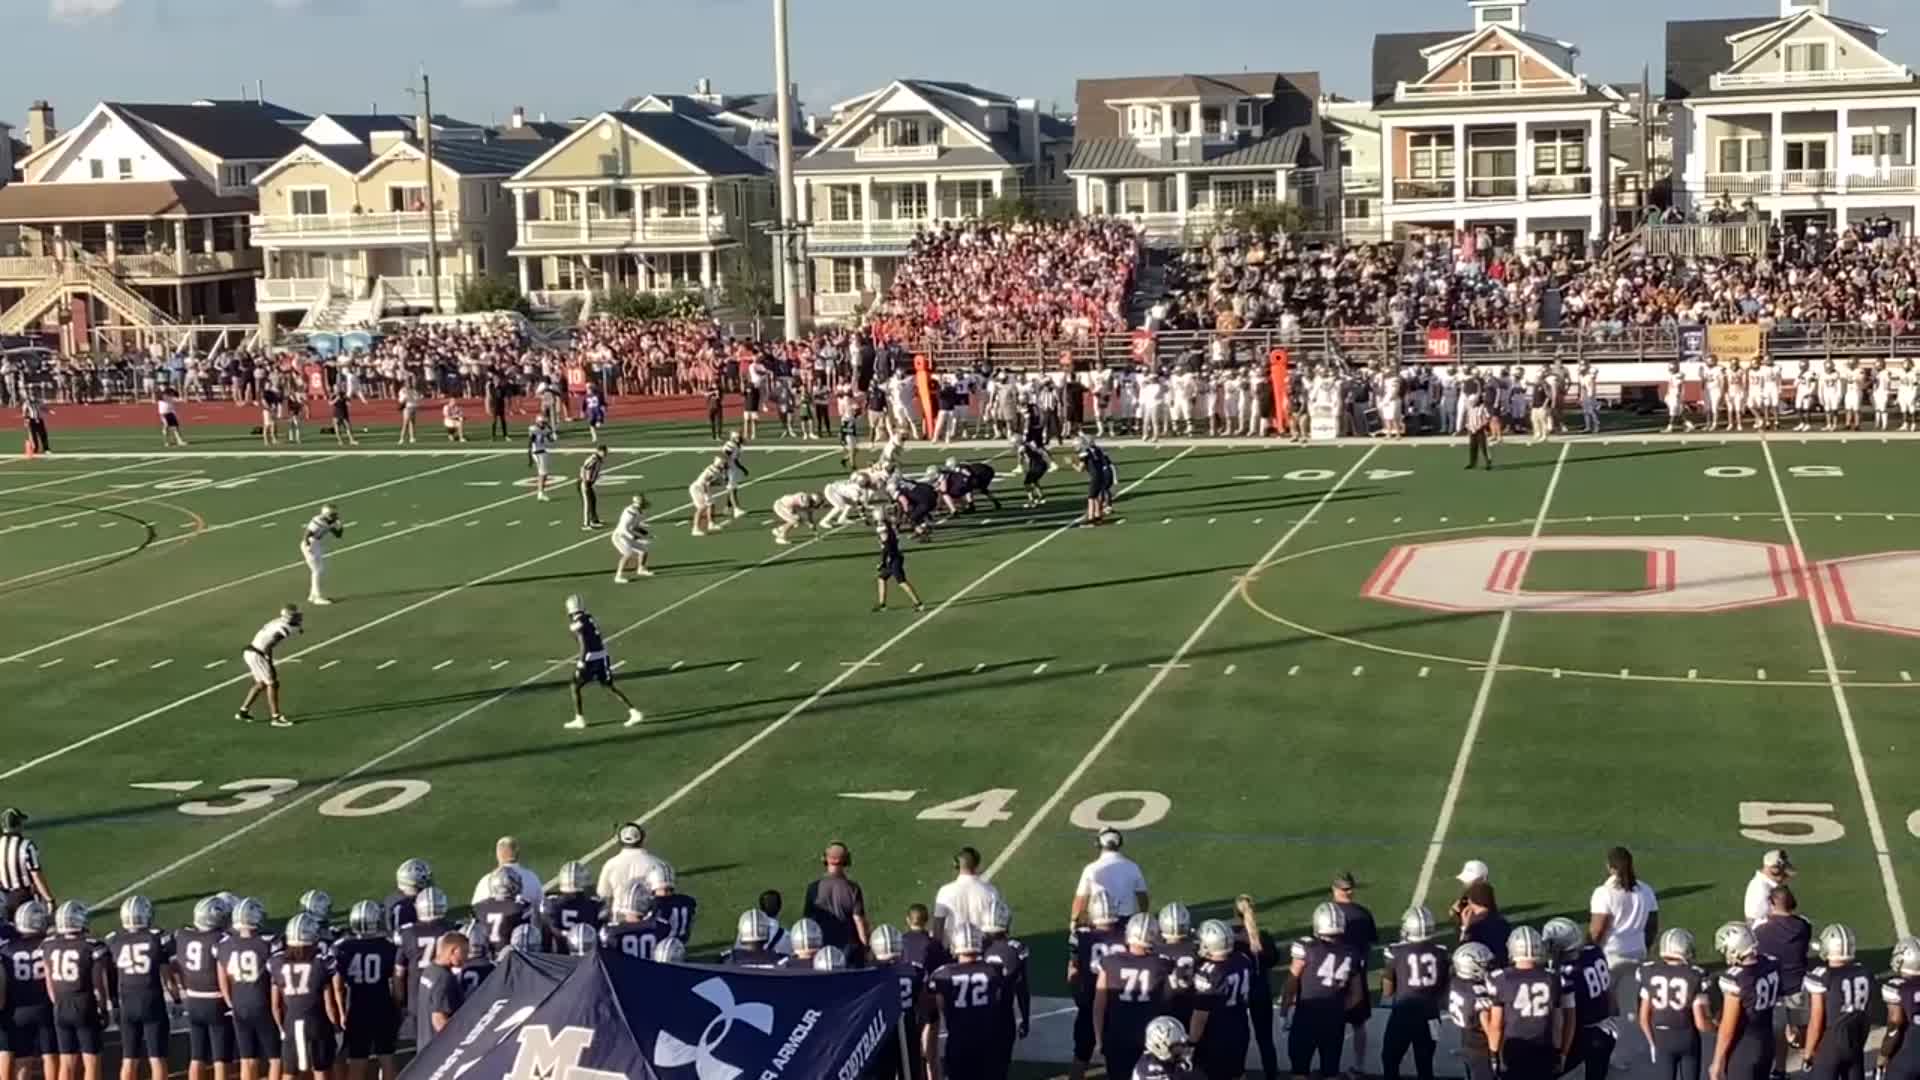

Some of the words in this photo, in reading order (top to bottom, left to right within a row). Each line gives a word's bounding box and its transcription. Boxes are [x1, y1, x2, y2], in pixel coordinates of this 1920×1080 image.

[485, 911, 504, 943] 7
[49, 948, 80, 982] 16
[116, 941, 152, 976] 45
[185, 940, 203, 972] 9
[225, 949, 259, 983] 49
[347, 952, 382, 985] 40
[1316, 952, 1352, 988] 44
[1406, 952, 1438, 988] 13
[280, 962, 312, 996] 17
[951, 972, 990, 1009] 72
[1119, 967, 1152, 1002] 71
[1583, 954, 1611, 1000] 88
[1649, 975, 1689, 1011] 33
[1754, 973, 1780, 1011] 87
[1840, 975, 1870, 1013] 18
[1512, 981, 1551, 1018] 42
[772, 1008, 824, 1072] ARMOUR
